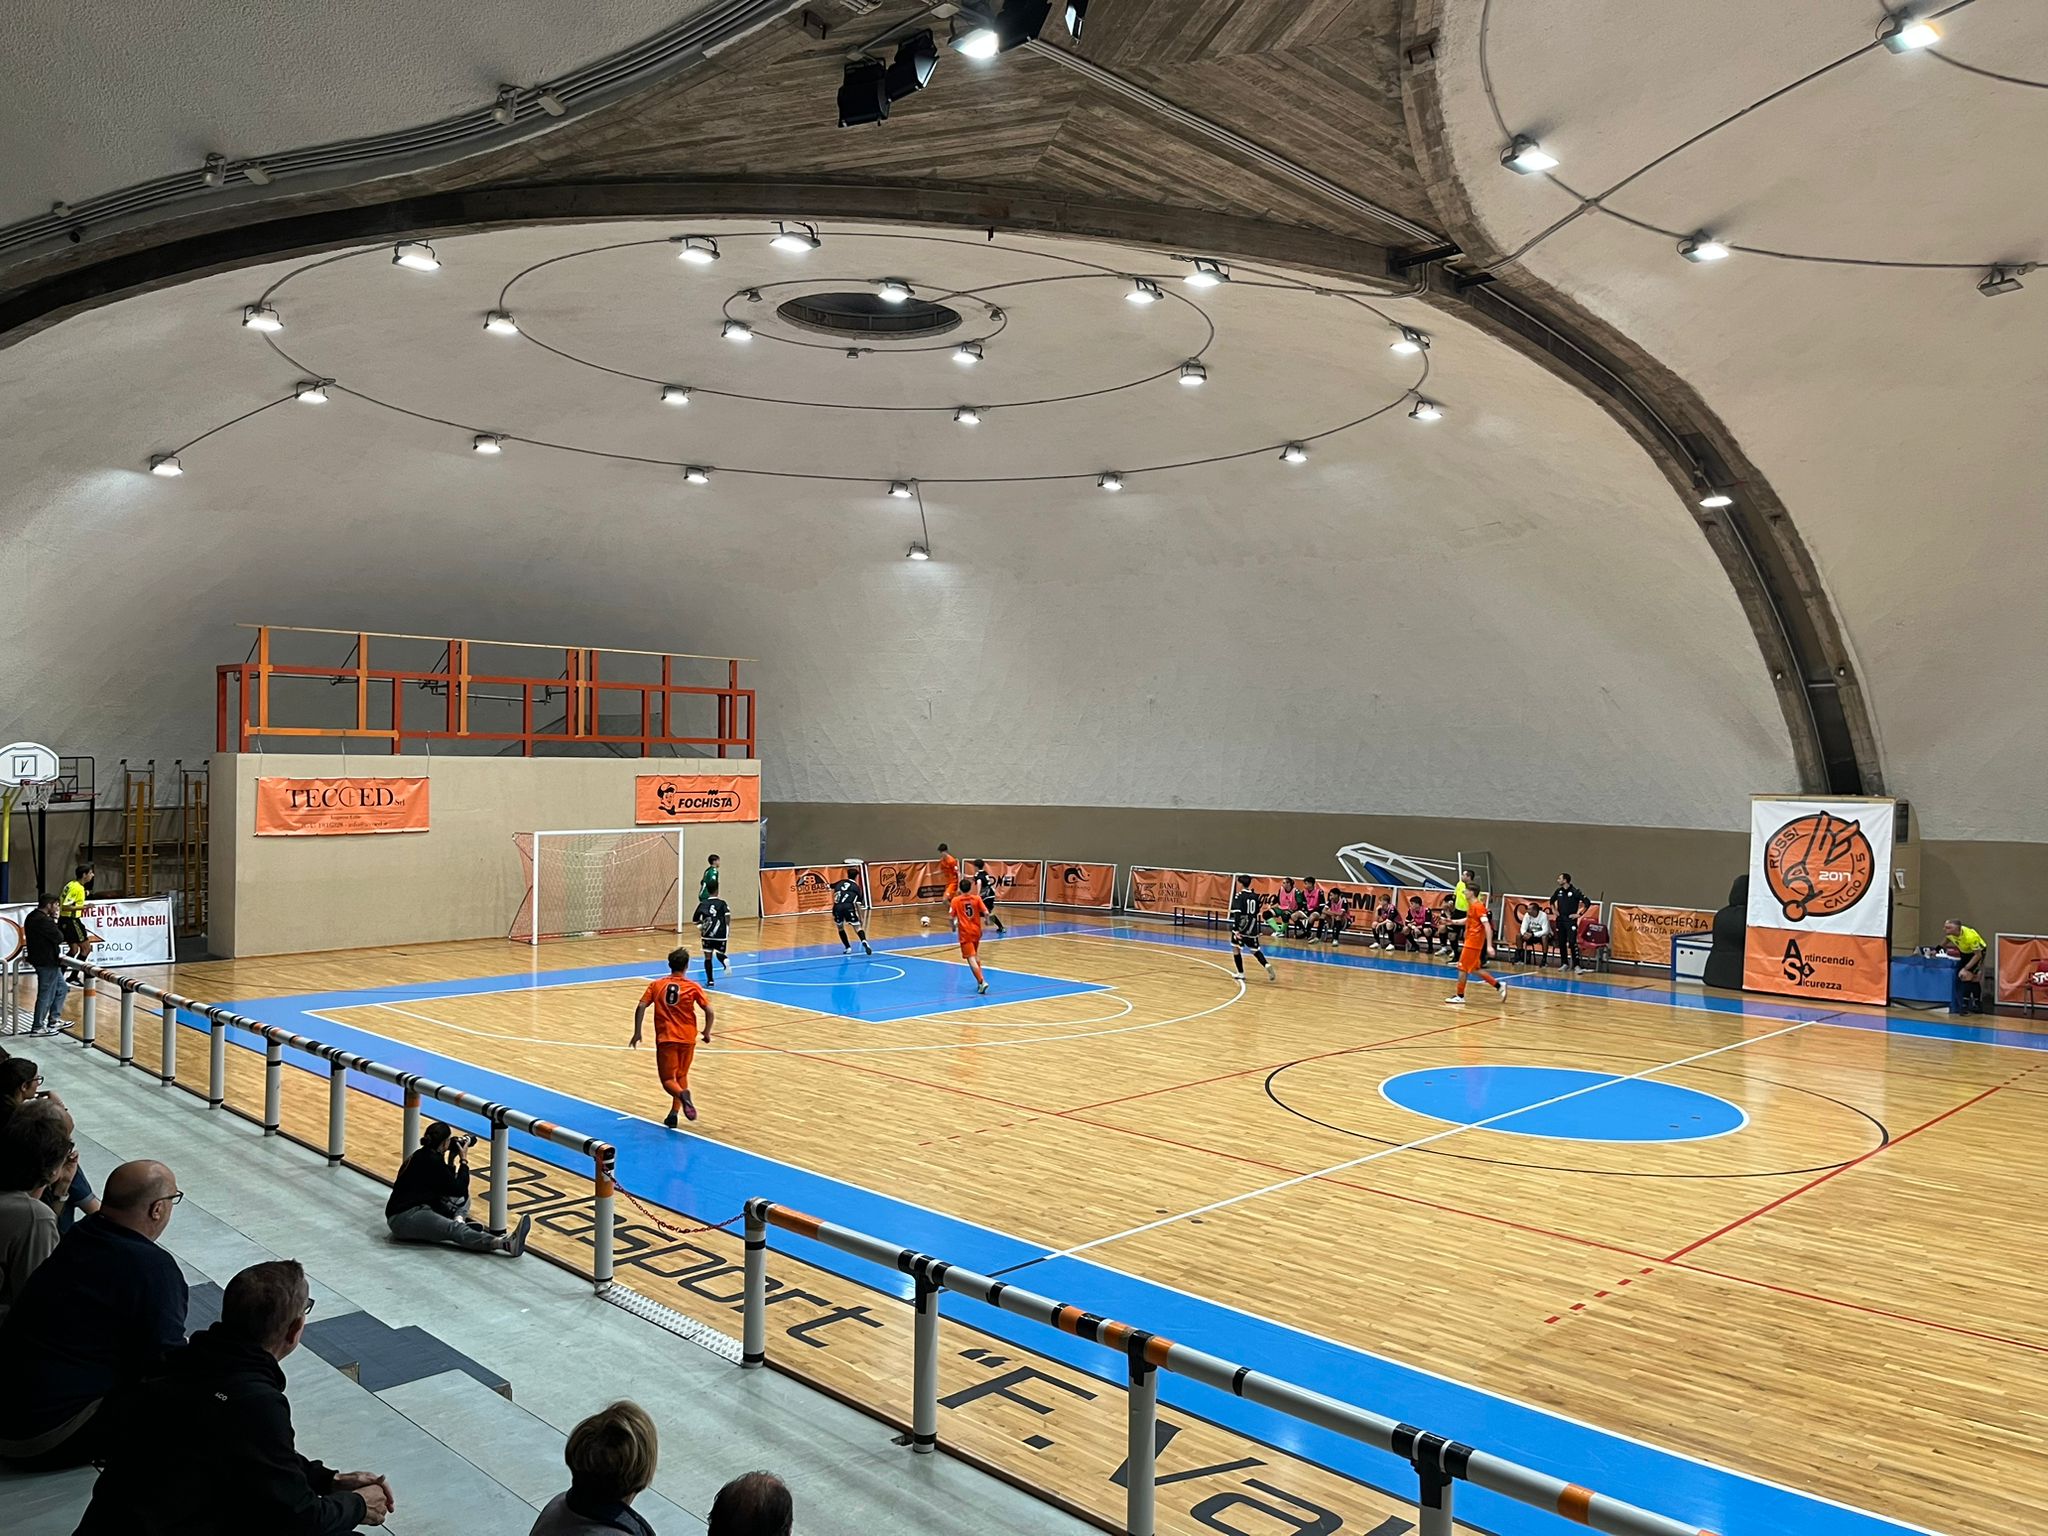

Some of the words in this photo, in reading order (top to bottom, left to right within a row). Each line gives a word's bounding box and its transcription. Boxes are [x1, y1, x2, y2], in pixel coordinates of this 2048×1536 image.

[678, 797, 733, 809] FOCHISTA
[1769, 826, 1800, 869] RUSSI
[1818, 871, 1852, 882] 2017
[840, 882, 850, 891] 3
[1823, 879, 1862, 909] CALCIO
[964, 902, 974, 917] 5
[1246, 899, 1256, 915] 10
[96, 917, 103, 928] E
[106, 914, 167, 927] CASALINGHI
[1628, 913, 1709, 930] TABACCHERIA
[97, 942, 134, 953] PAOLO
[665, 983, 680, 1005] 8
